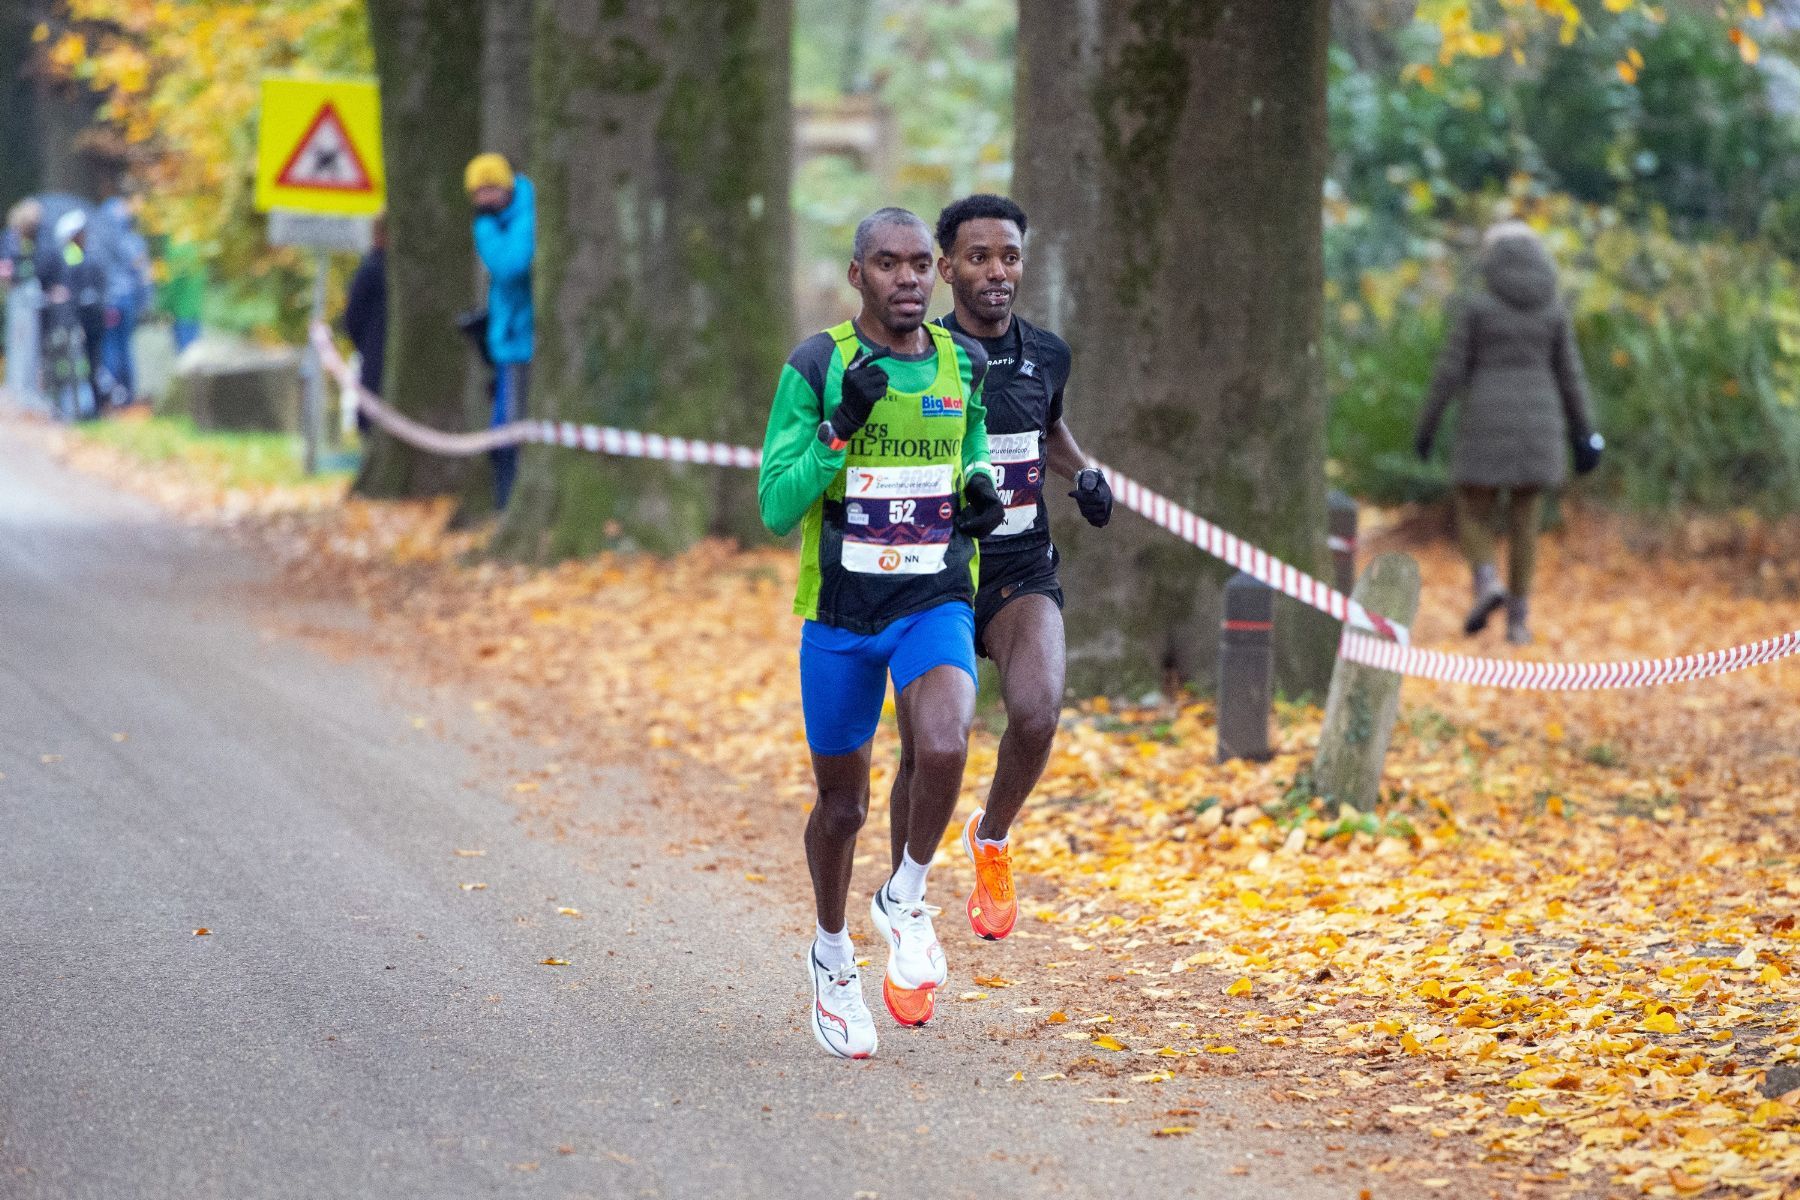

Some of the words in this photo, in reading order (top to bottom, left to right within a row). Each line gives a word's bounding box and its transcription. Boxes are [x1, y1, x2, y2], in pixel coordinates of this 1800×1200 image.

[986, 358, 1008, 366] RAFT
[850, 438, 873, 456] IL
[888, 499, 917, 525] 52
[904, 555, 919, 563] NN
